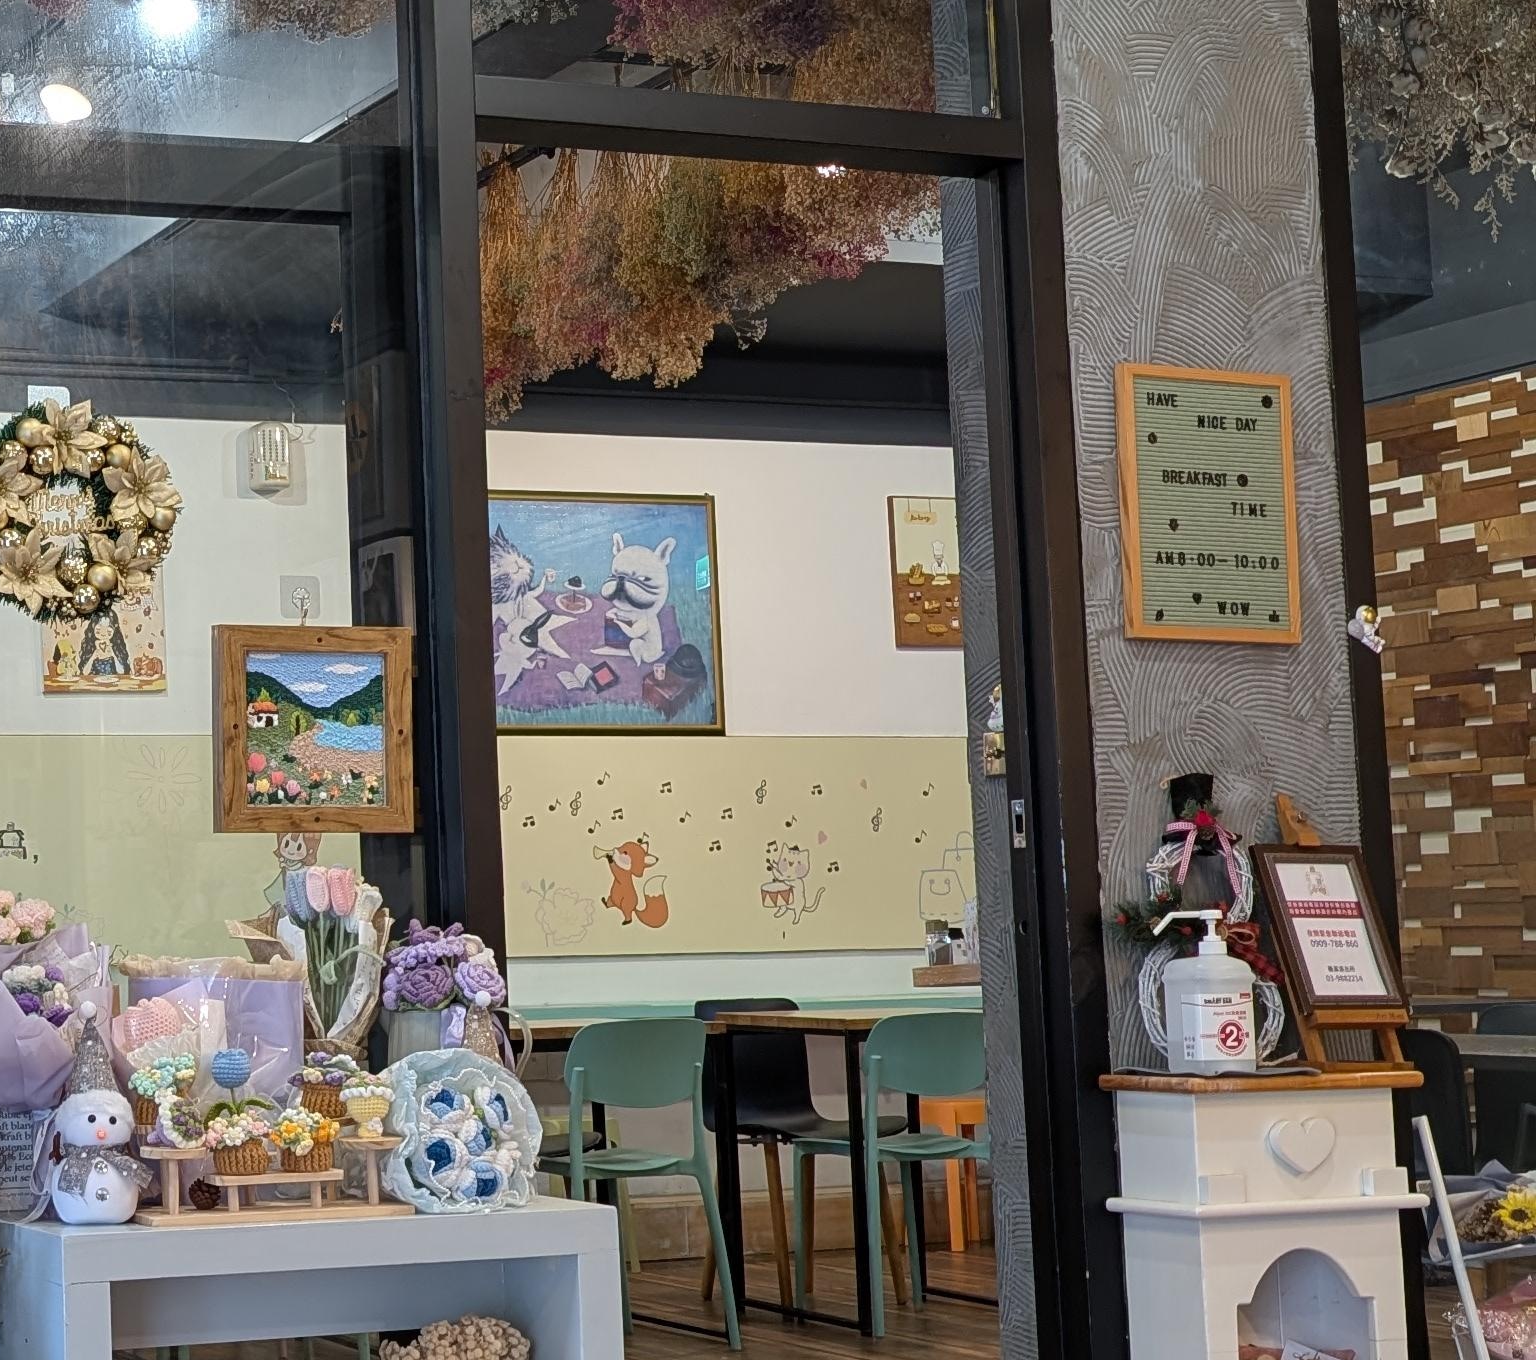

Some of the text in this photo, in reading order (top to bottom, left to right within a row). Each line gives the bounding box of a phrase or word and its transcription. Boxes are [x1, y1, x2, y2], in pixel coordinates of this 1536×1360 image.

[1146, 392, 1179, 408] HAVE
[1197, 415, 1258, 432] NICE DAY
[1162, 469, 1228, 487] BREAKFAST
[1230, 502, 1268, 518] TIME
[1217, 601, 1251, 617] WOW
[1225, 1025, 1239, 1046] 2
